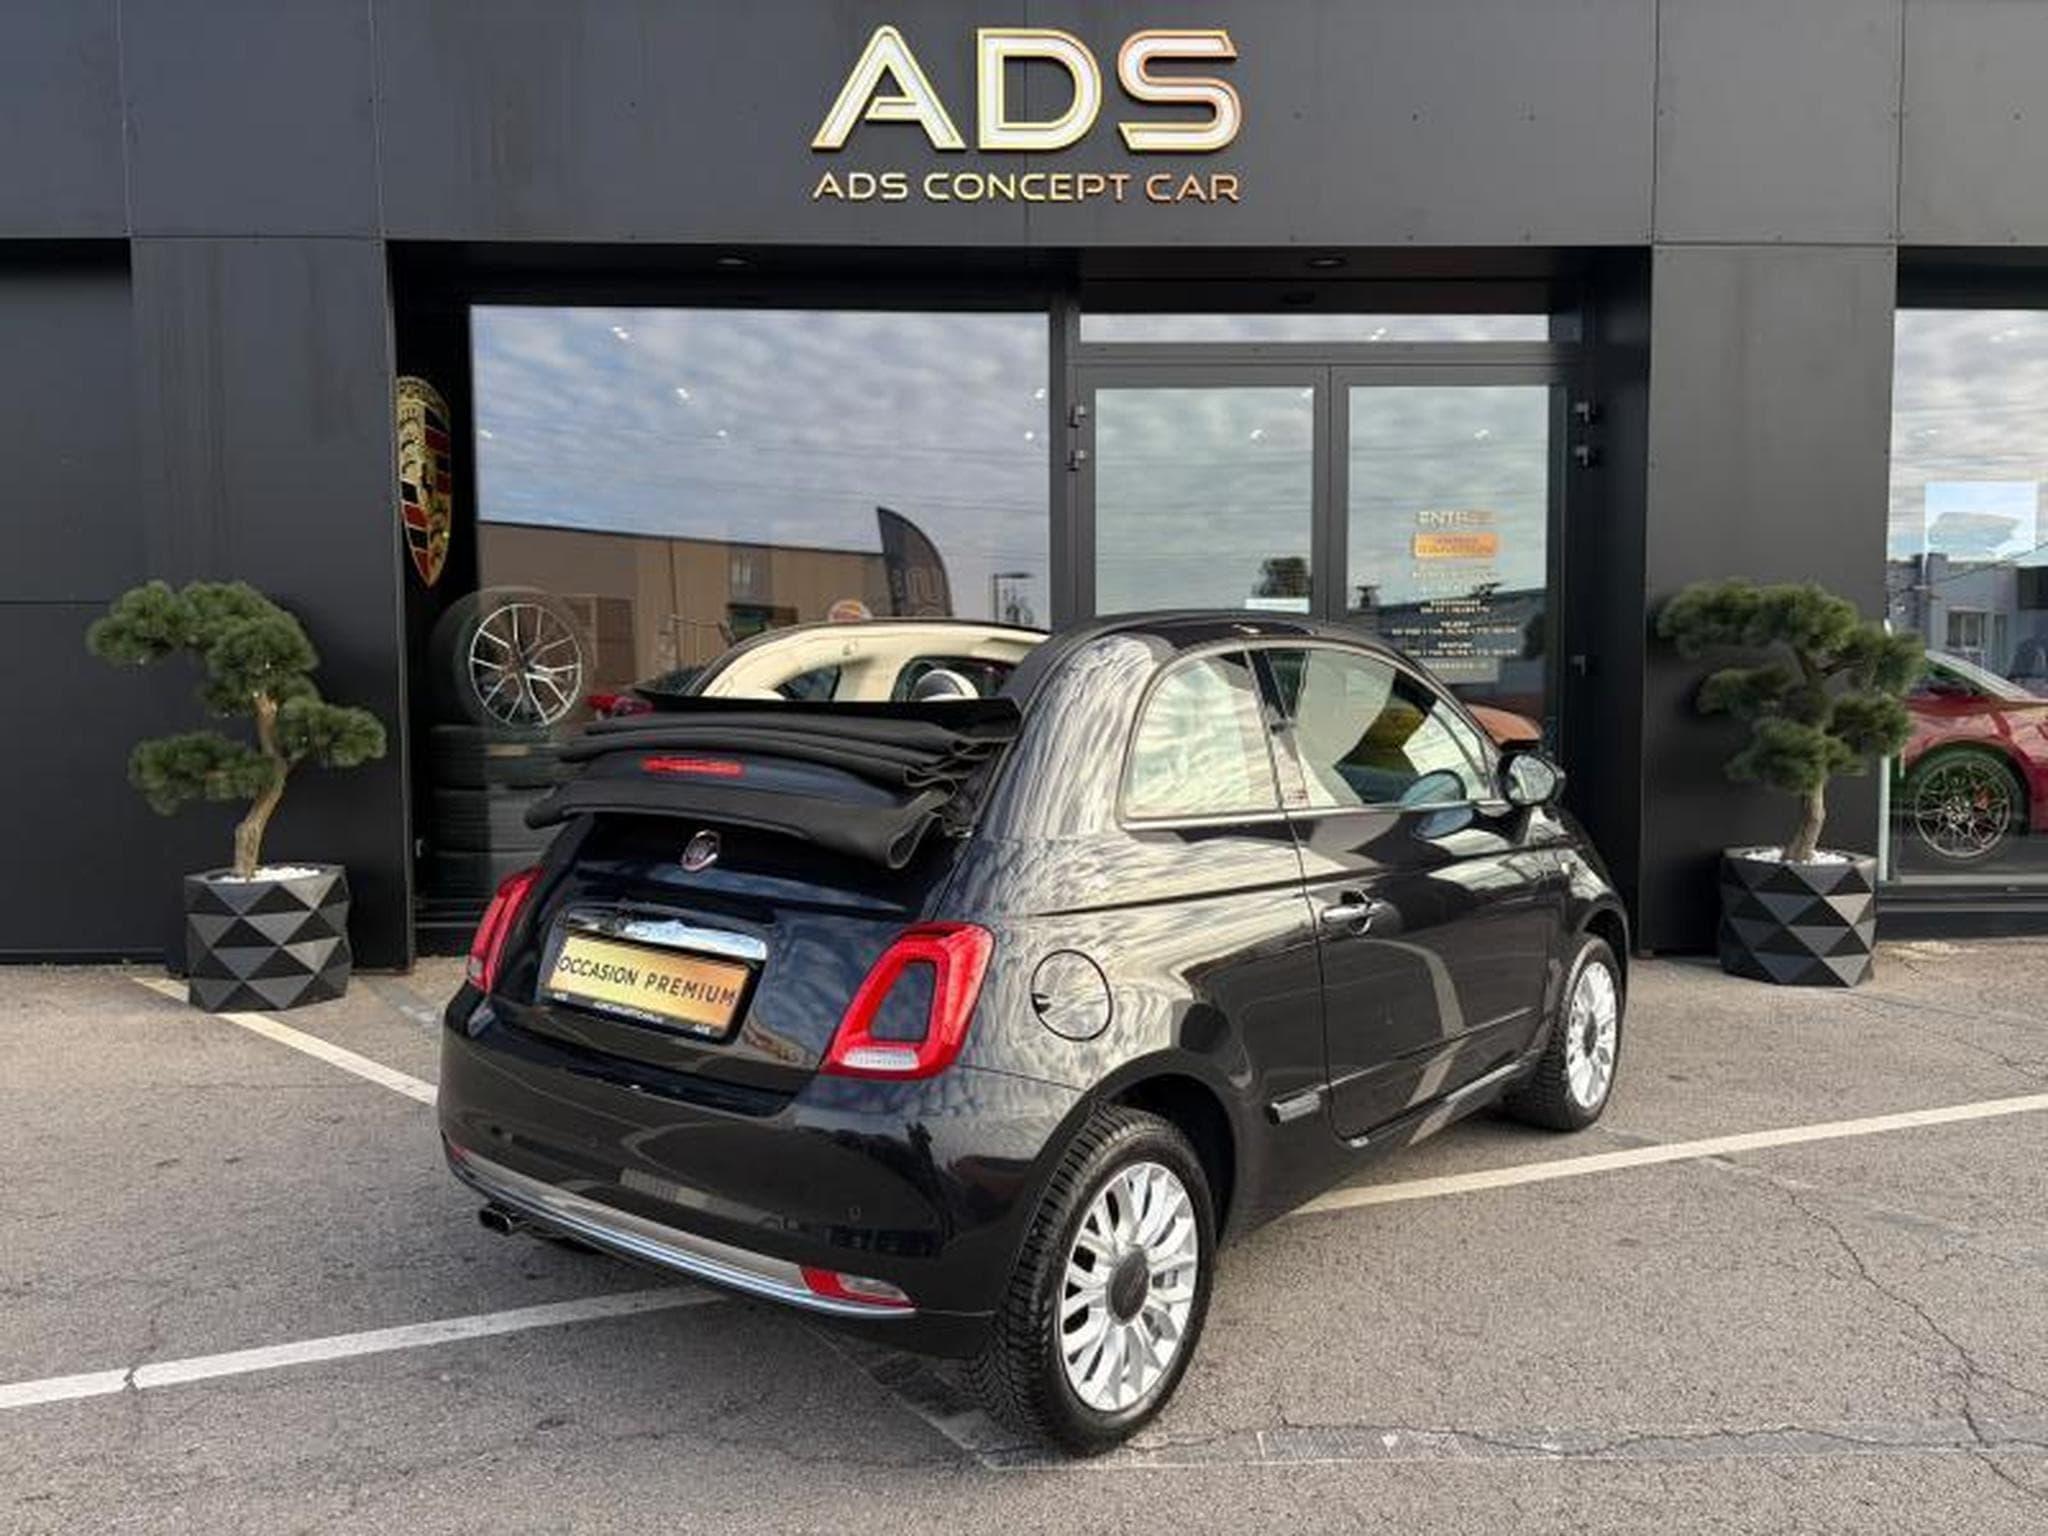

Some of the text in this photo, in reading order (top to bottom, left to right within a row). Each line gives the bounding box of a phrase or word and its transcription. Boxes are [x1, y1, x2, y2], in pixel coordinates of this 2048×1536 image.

[811, 25, 1242, 151] ADS
[812, 172, 1241, 203] ADS CONCEPT CAR
[557, 955, 737, 1006] OCCASION PREMIUM
